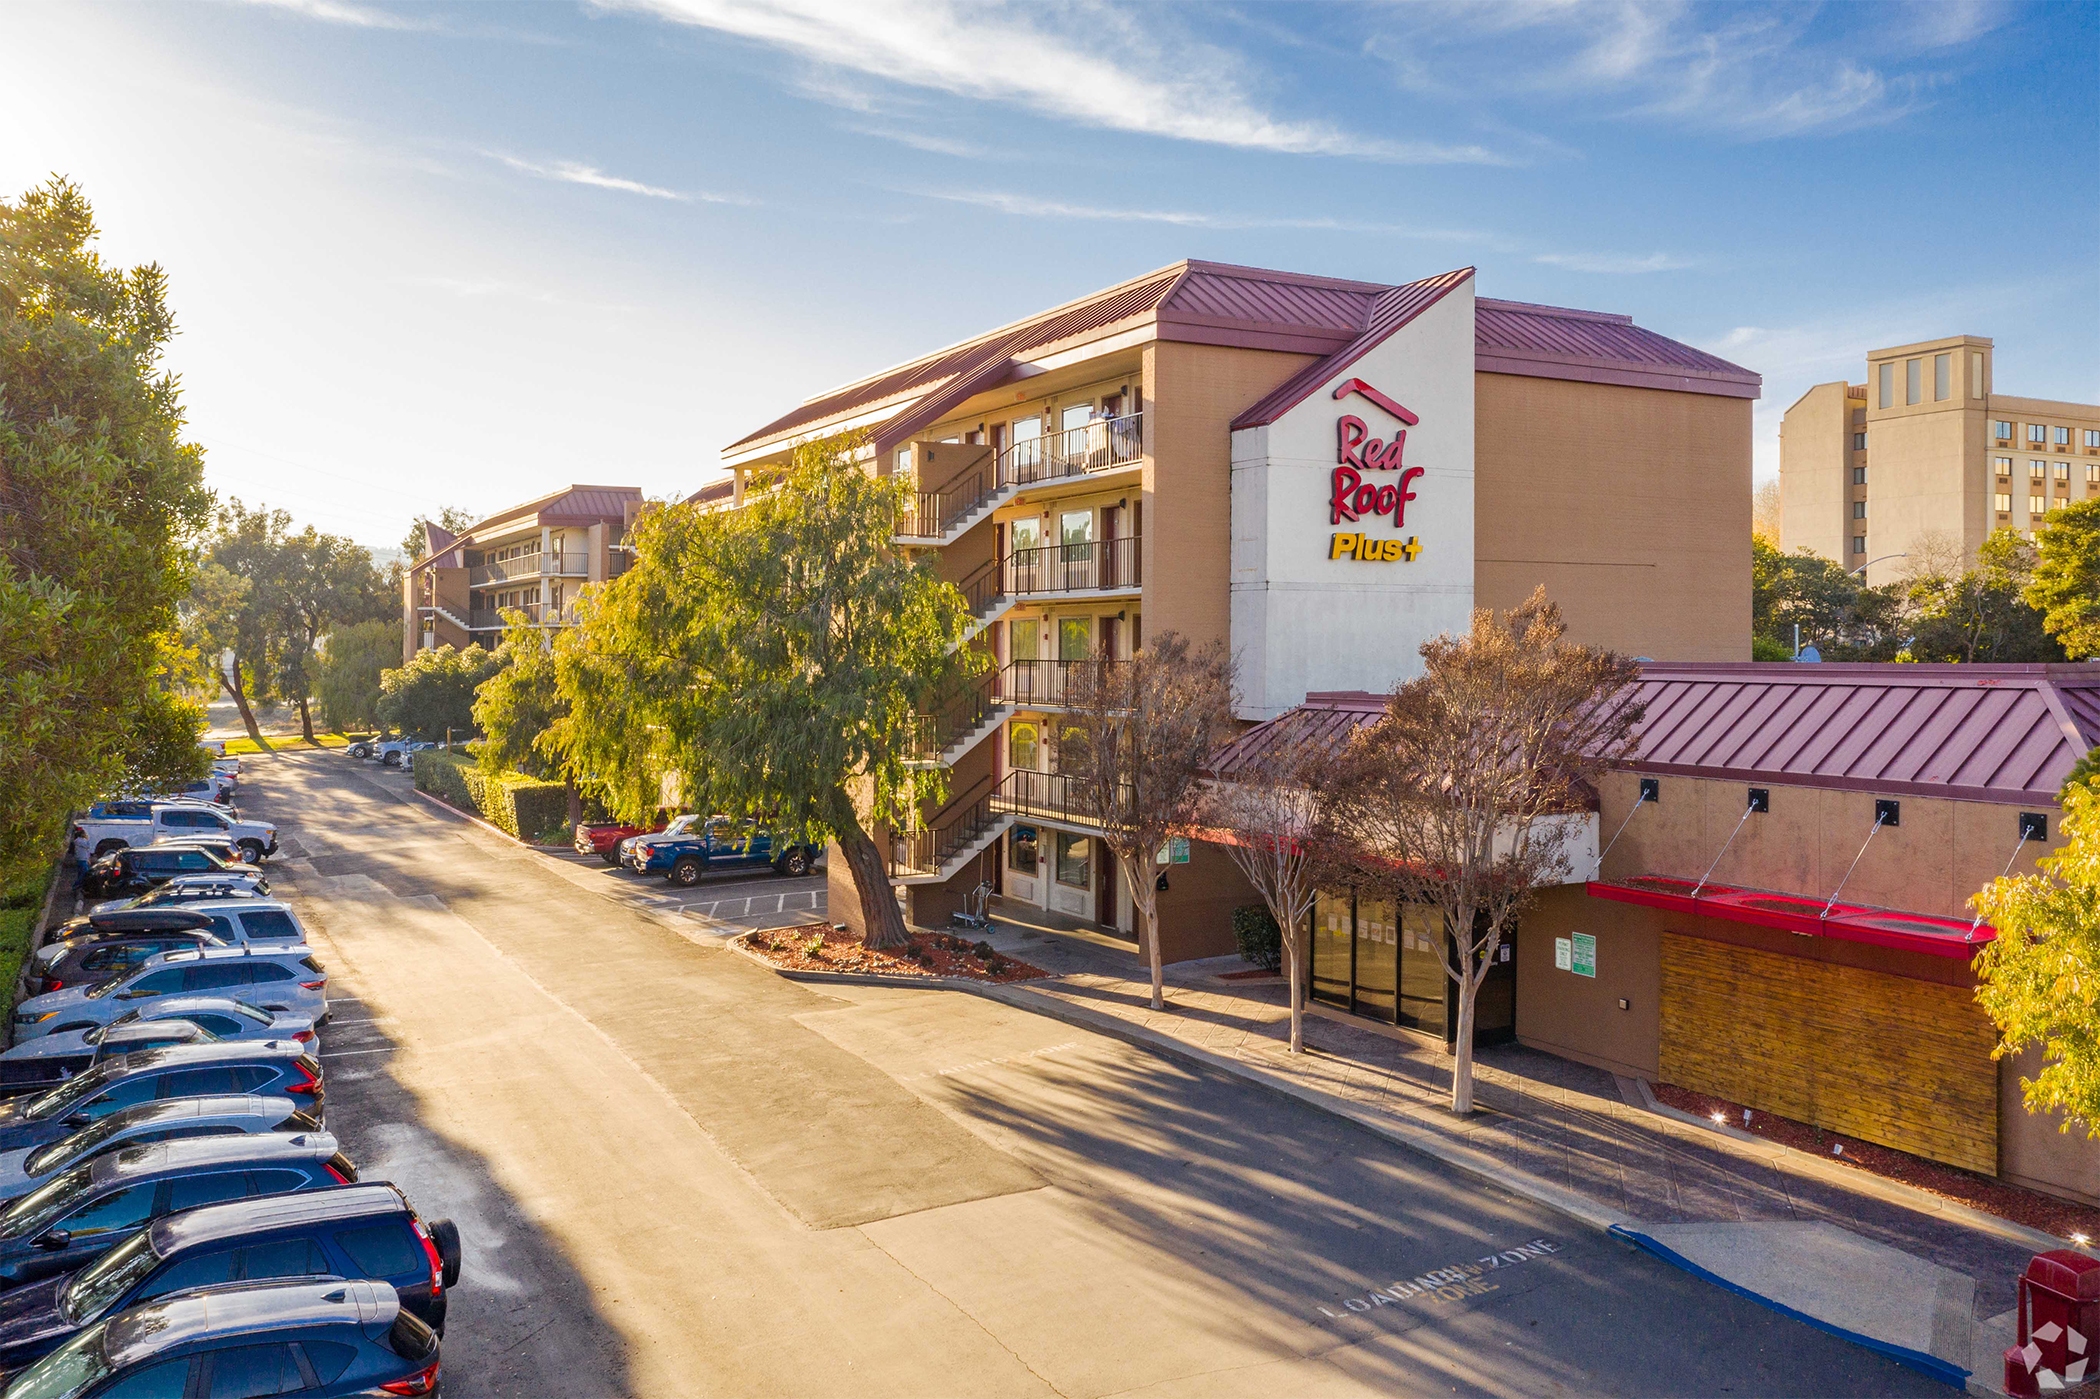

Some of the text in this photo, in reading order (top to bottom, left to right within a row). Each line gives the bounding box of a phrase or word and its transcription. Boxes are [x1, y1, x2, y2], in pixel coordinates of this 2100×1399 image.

[1337, 415, 1406, 470] Red
[1330, 466, 1424, 528] Roof
[1328, 533, 1423, 562] Plus+
[1317, 1266, 1468, 1319] LOADING
[1478, 1239, 1559, 1269] ZONE
